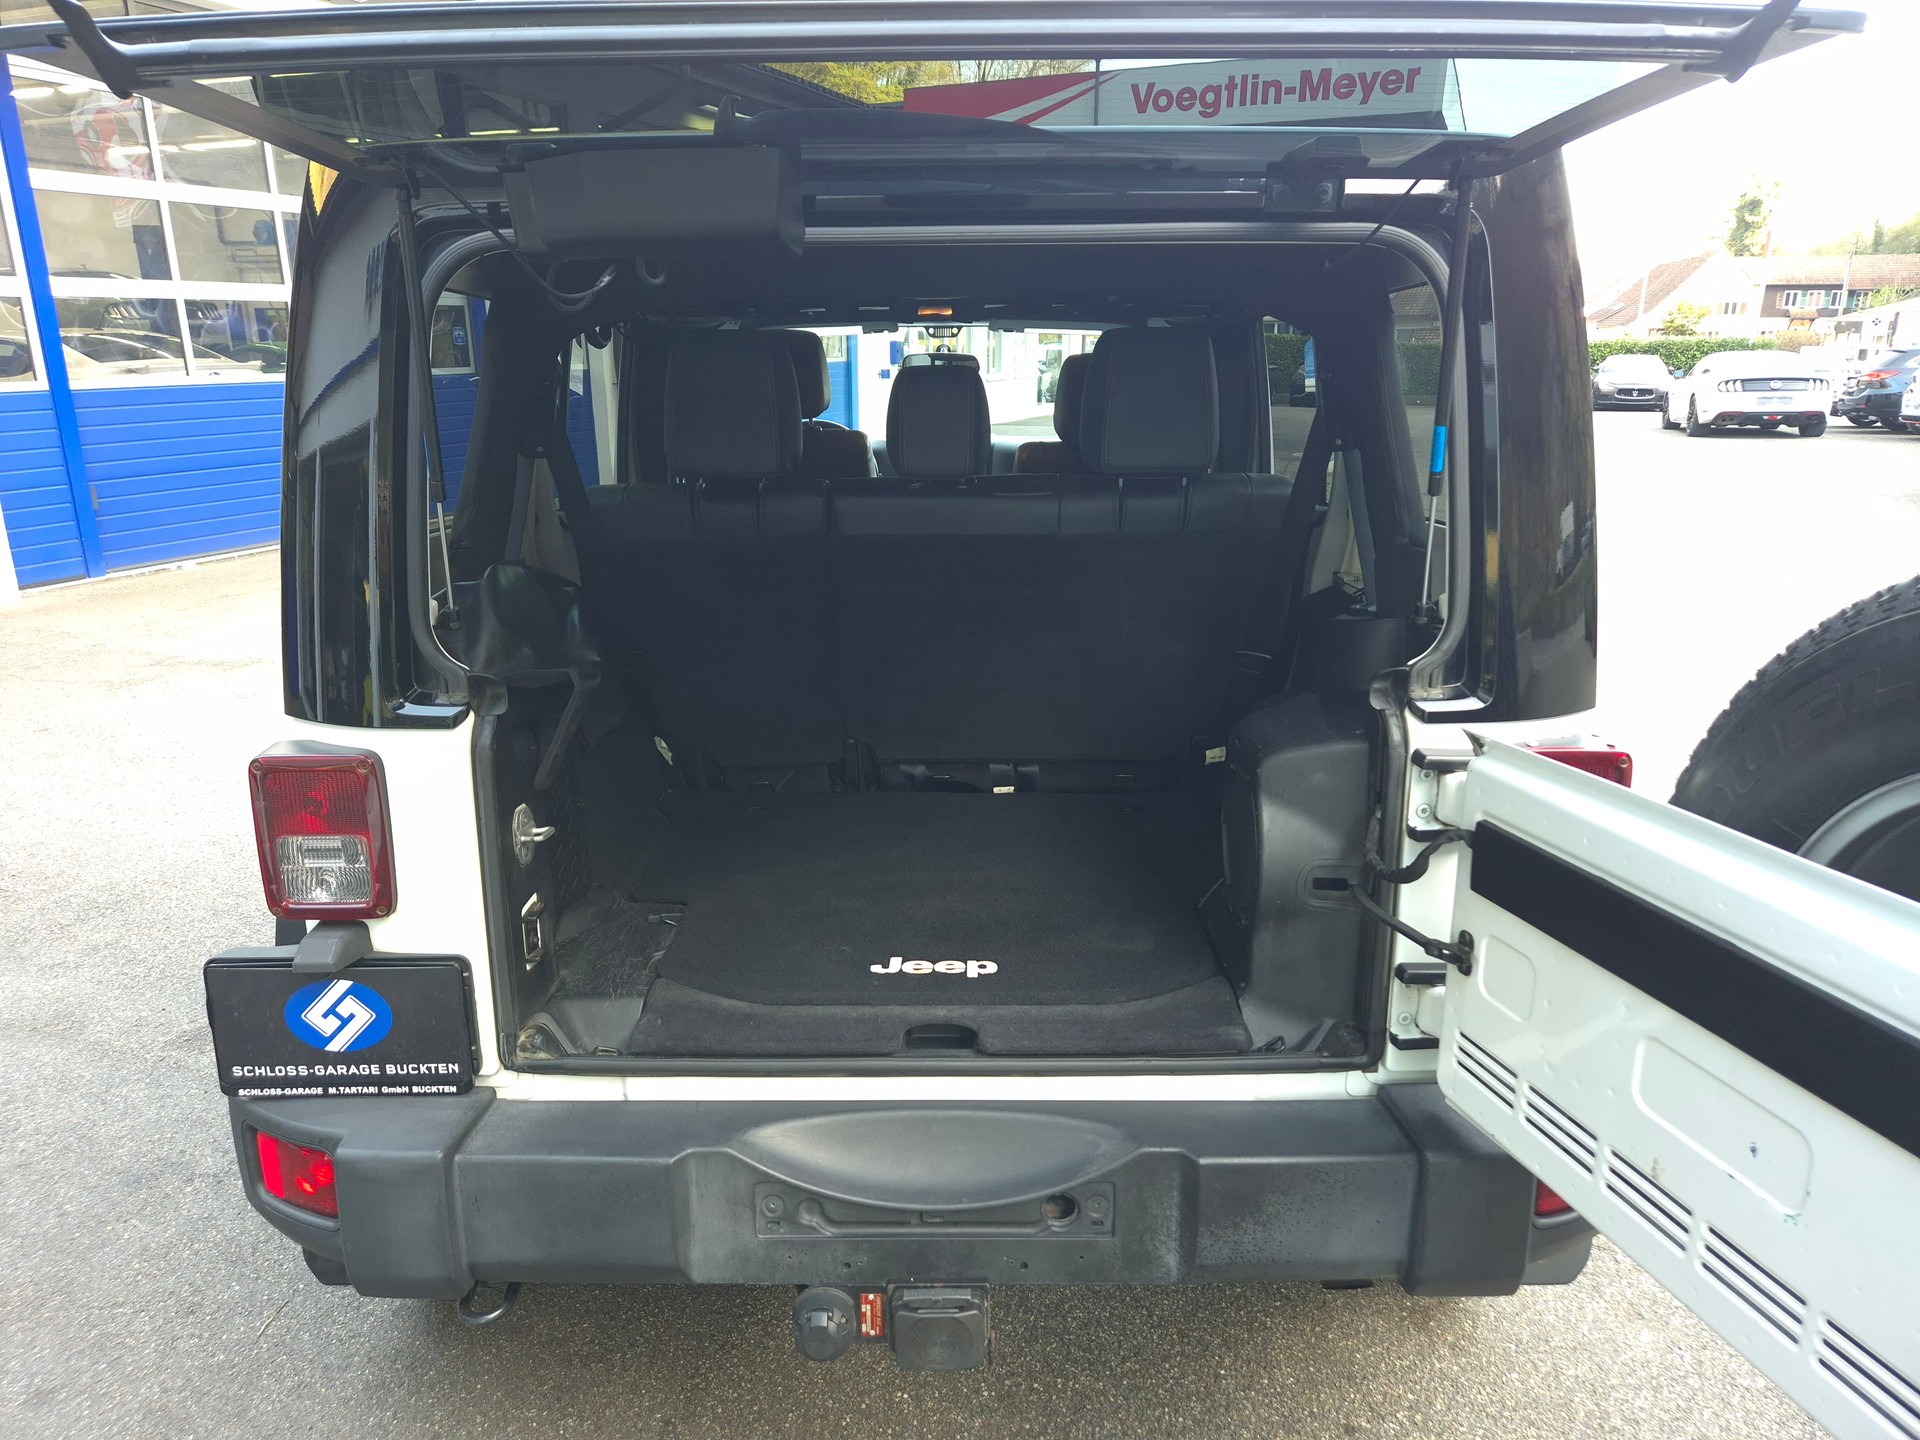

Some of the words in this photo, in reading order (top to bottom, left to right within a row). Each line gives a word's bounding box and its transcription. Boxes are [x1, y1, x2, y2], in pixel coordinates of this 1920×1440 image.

[1131, 66, 1422, 118] Voegtlin-Meyer
[869, 956, 999, 979] Jeep
[231, 1064, 381, 1077] SCHLOSS-GARAGE
[385, 1062, 460, 1075] BUCKTEN
[238, 1086, 324, 1096] SCHLOSS-GARAGE
[381, 1085, 409, 1094] GmbH
[412, 1085, 457, 1094] BUCKTEN
